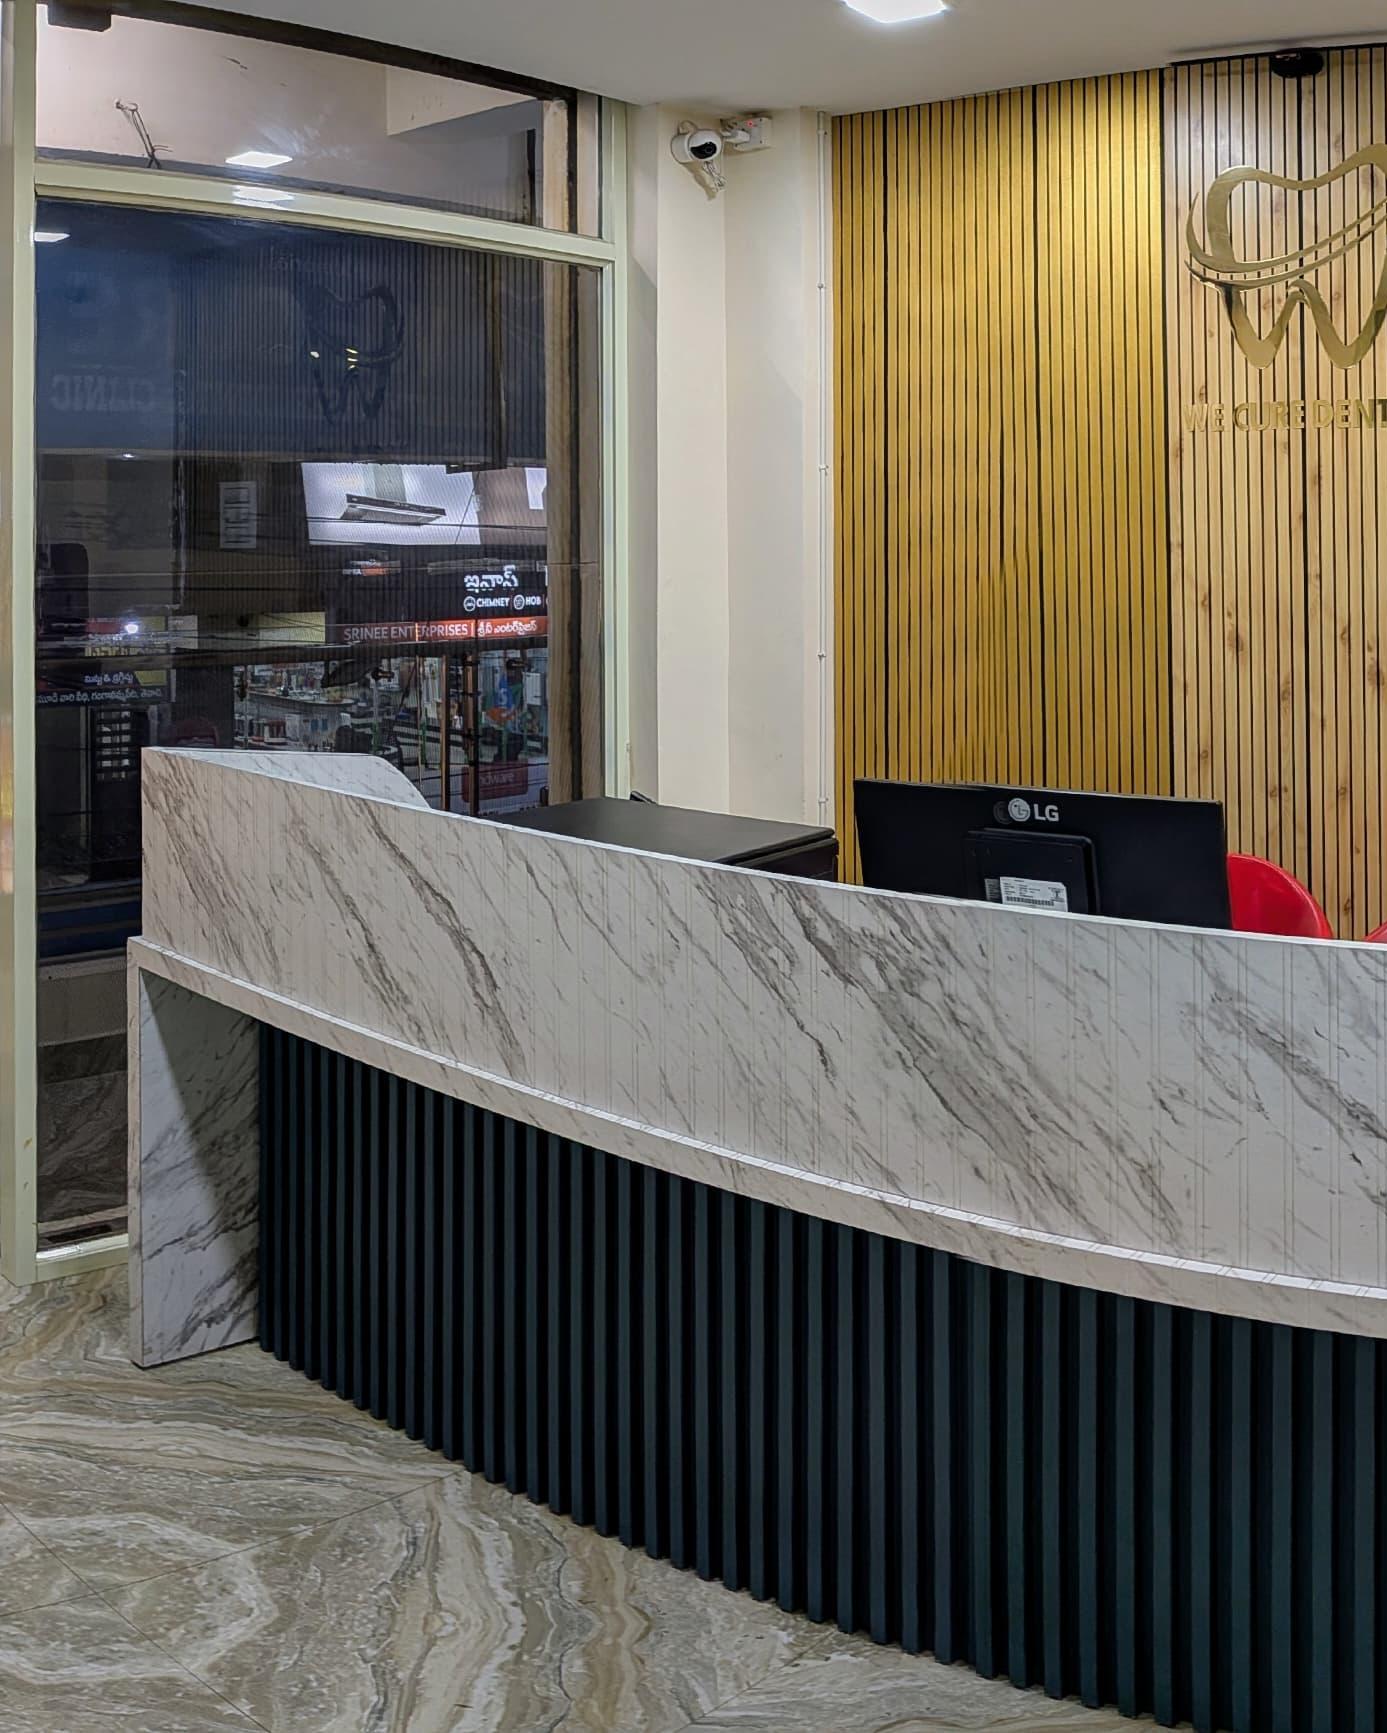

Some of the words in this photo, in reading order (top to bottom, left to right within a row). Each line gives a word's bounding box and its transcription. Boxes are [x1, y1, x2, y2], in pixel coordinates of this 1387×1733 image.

[1183, 402, 1225, 432] WE
[1232, 400, 1305, 431] CURE
[476, 597, 511, 608] CHIMNEY
[525, 595, 542, 606] HOB
[343, 626, 390, 641] SRINEE
[390, 623, 468, 639] ENTERPRISES
[1034, 803, 1060, 822] LG
